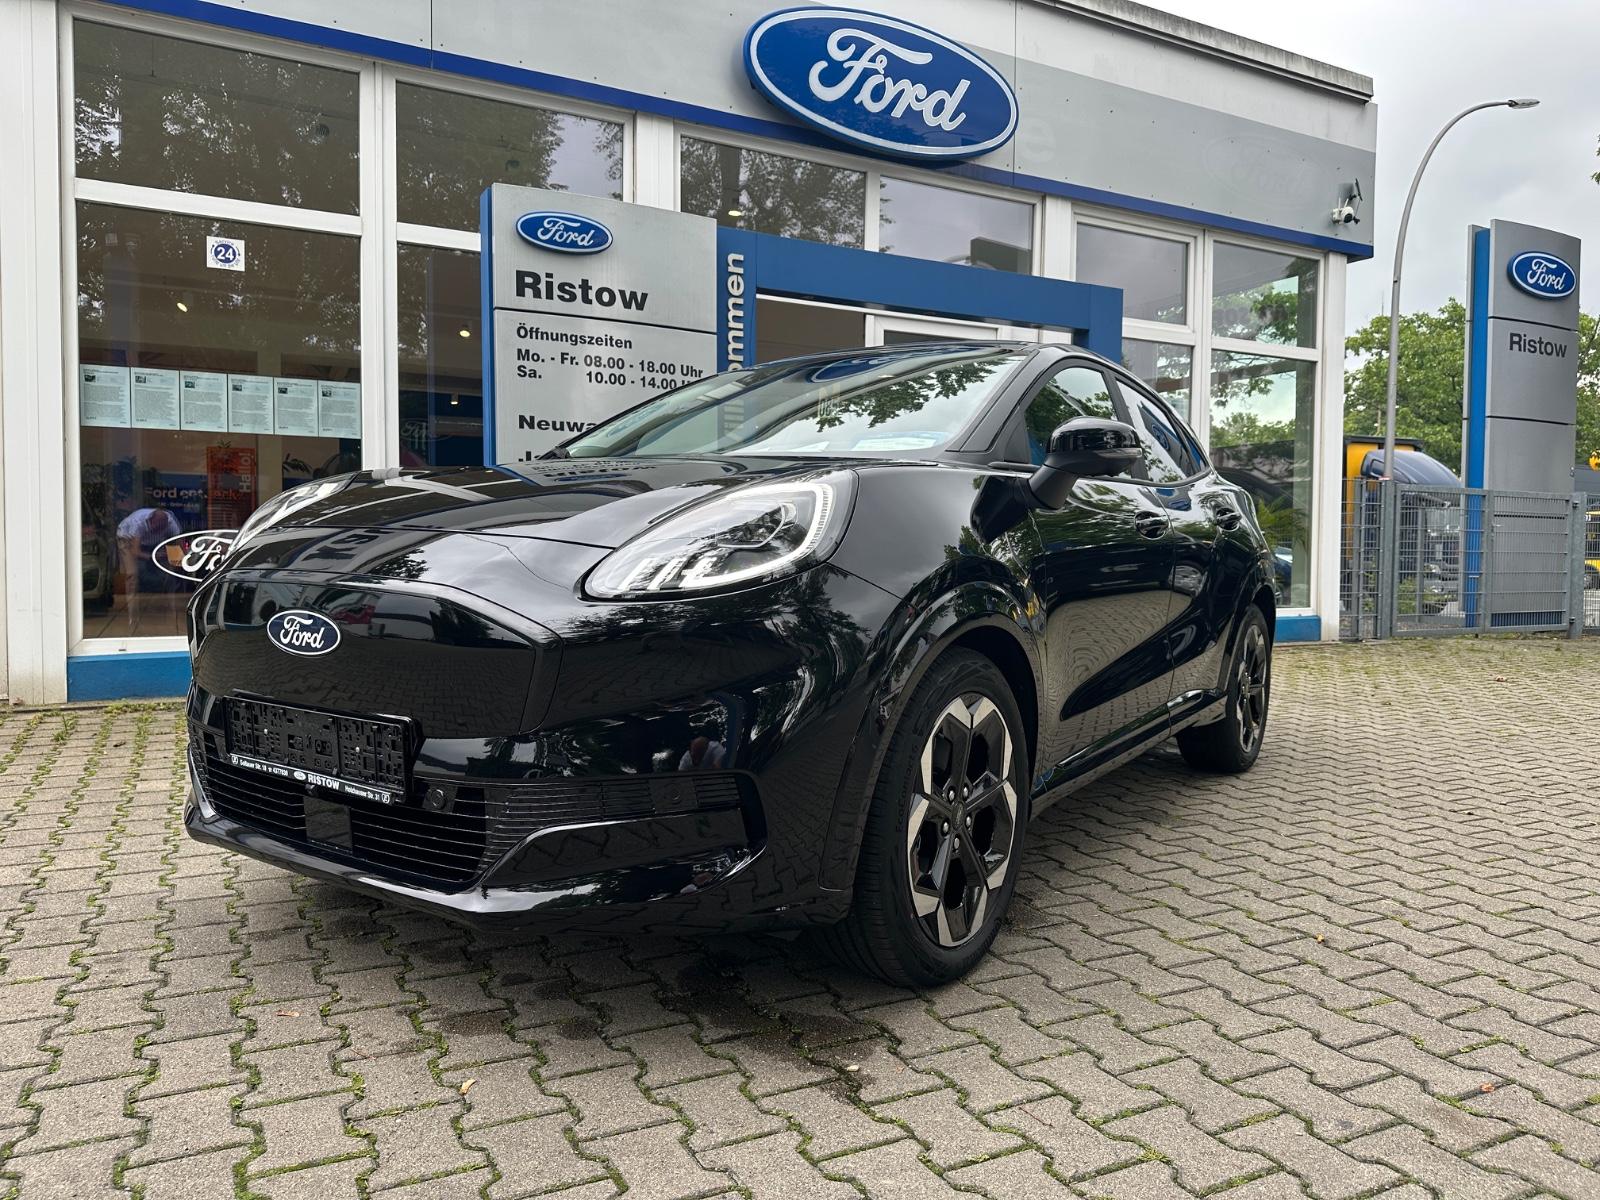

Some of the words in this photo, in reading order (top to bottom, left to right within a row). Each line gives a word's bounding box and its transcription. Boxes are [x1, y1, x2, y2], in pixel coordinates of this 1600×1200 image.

[808, 28, 970, 131] Ford
[537, 217, 595, 247] Ford
[216, 246, 235, 261] 24
[1527, 258, 1566, 290] Ford
[515, 269, 648, 311] Ristow
[516, 323, 633, 350] Öffnungszeiten
[1509, 332, 1567, 358] Ristow
[516, 348, 545, 363] Mo.
[560, 351, 579, 366] Fr.
[583, 354, 625, 370] 08.00
[639, 360, 676, 375] 18.00
[680, 364, 704, 378] Uhr
[516, 364, 542, 379] Sa.
[586, 371, 626, 386] 10.00
[640, 375, 677, 390] 14.00
[239, 452, 251, 493] Hallo!
[280, 615, 325, 649] Ford
[307, 773, 340, 790] RISTOW
